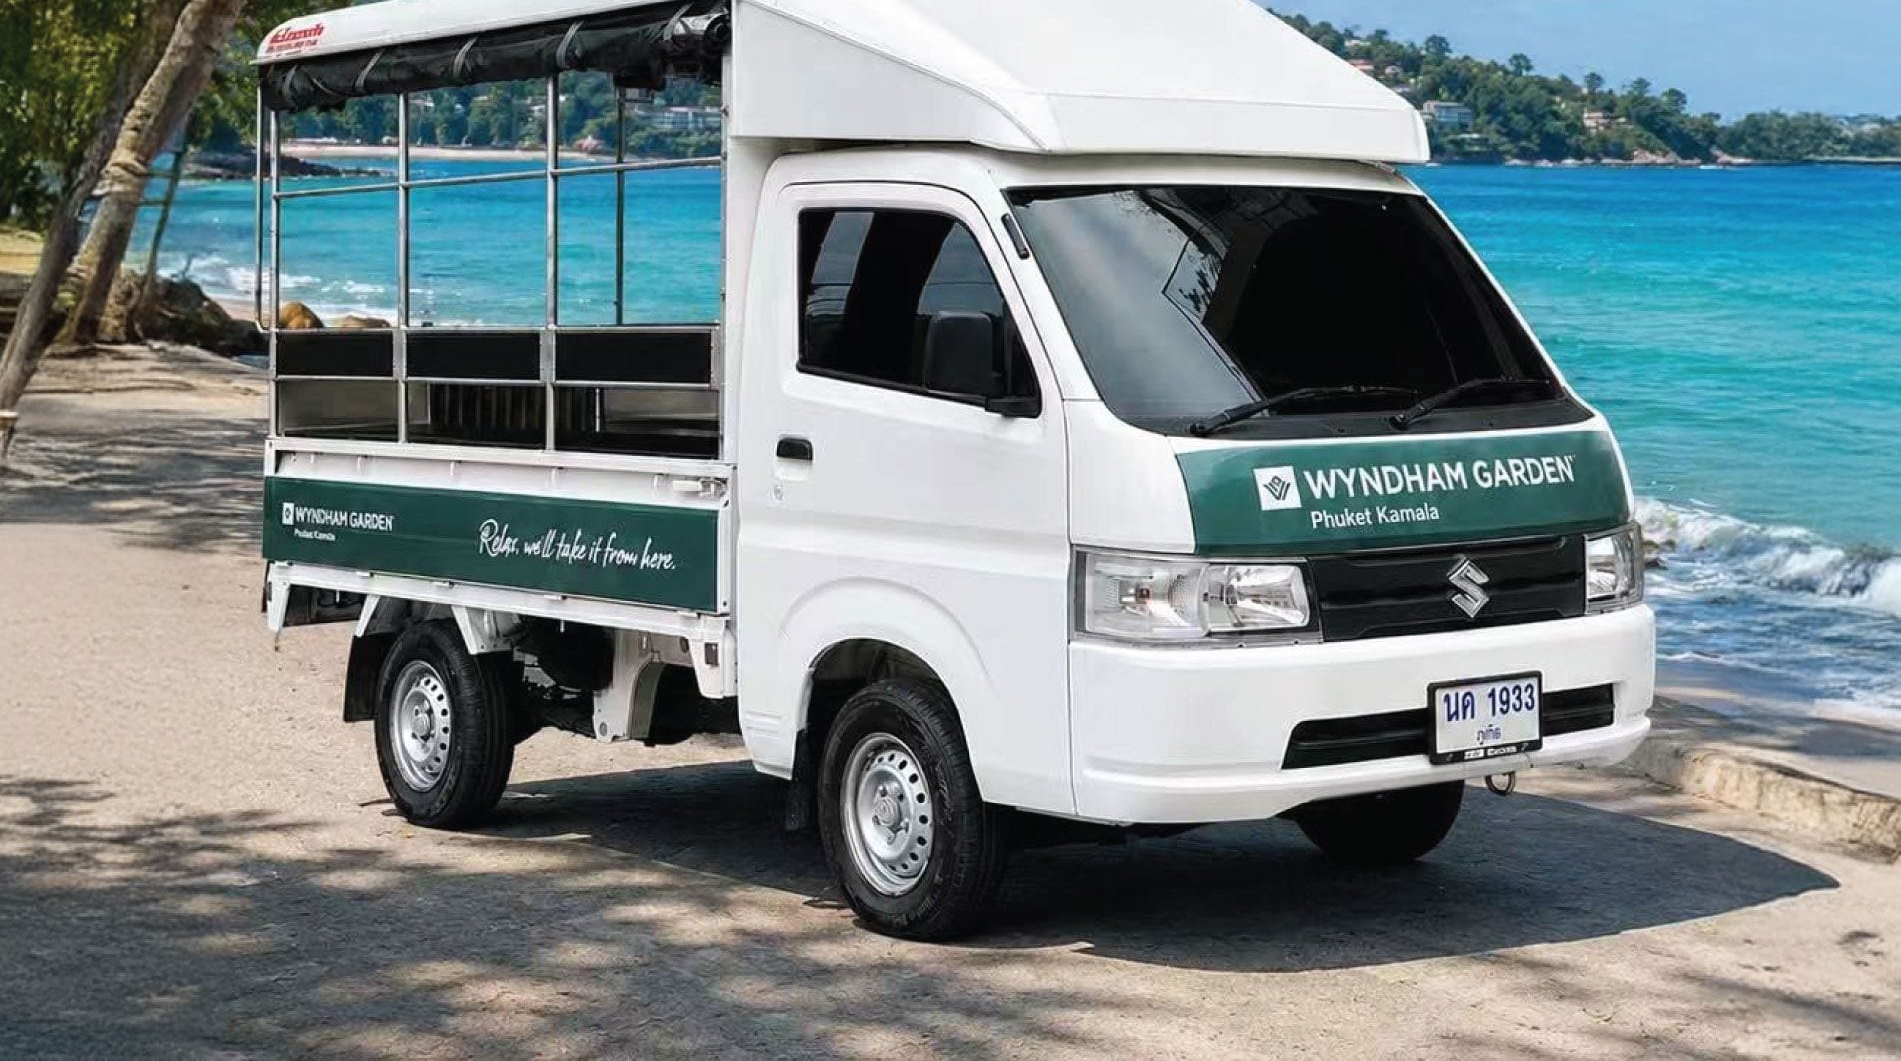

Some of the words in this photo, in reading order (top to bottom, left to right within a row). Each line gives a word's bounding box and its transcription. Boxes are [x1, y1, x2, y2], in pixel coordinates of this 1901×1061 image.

[1303, 461, 1469, 500] WYNDHAM
[1472, 455, 1575, 489] GARDEN
[295, 506, 348, 526] WYNDHAM
[349, 511, 393, 531] GARDEN
[1311, 507, 1371, 529] Phuket
[1377, 503, 1440, 524] Kamala
[478, 518, 519, 557] Relax,
[556, 528, 586, 564] take
[588, 536, 603, 564] it
[602, 532, 638, 568] from
[640, 537, 676, 570] here.
[1443, 691, 1475, 722] นค
[1488, 683, 1535, 717] 1933
